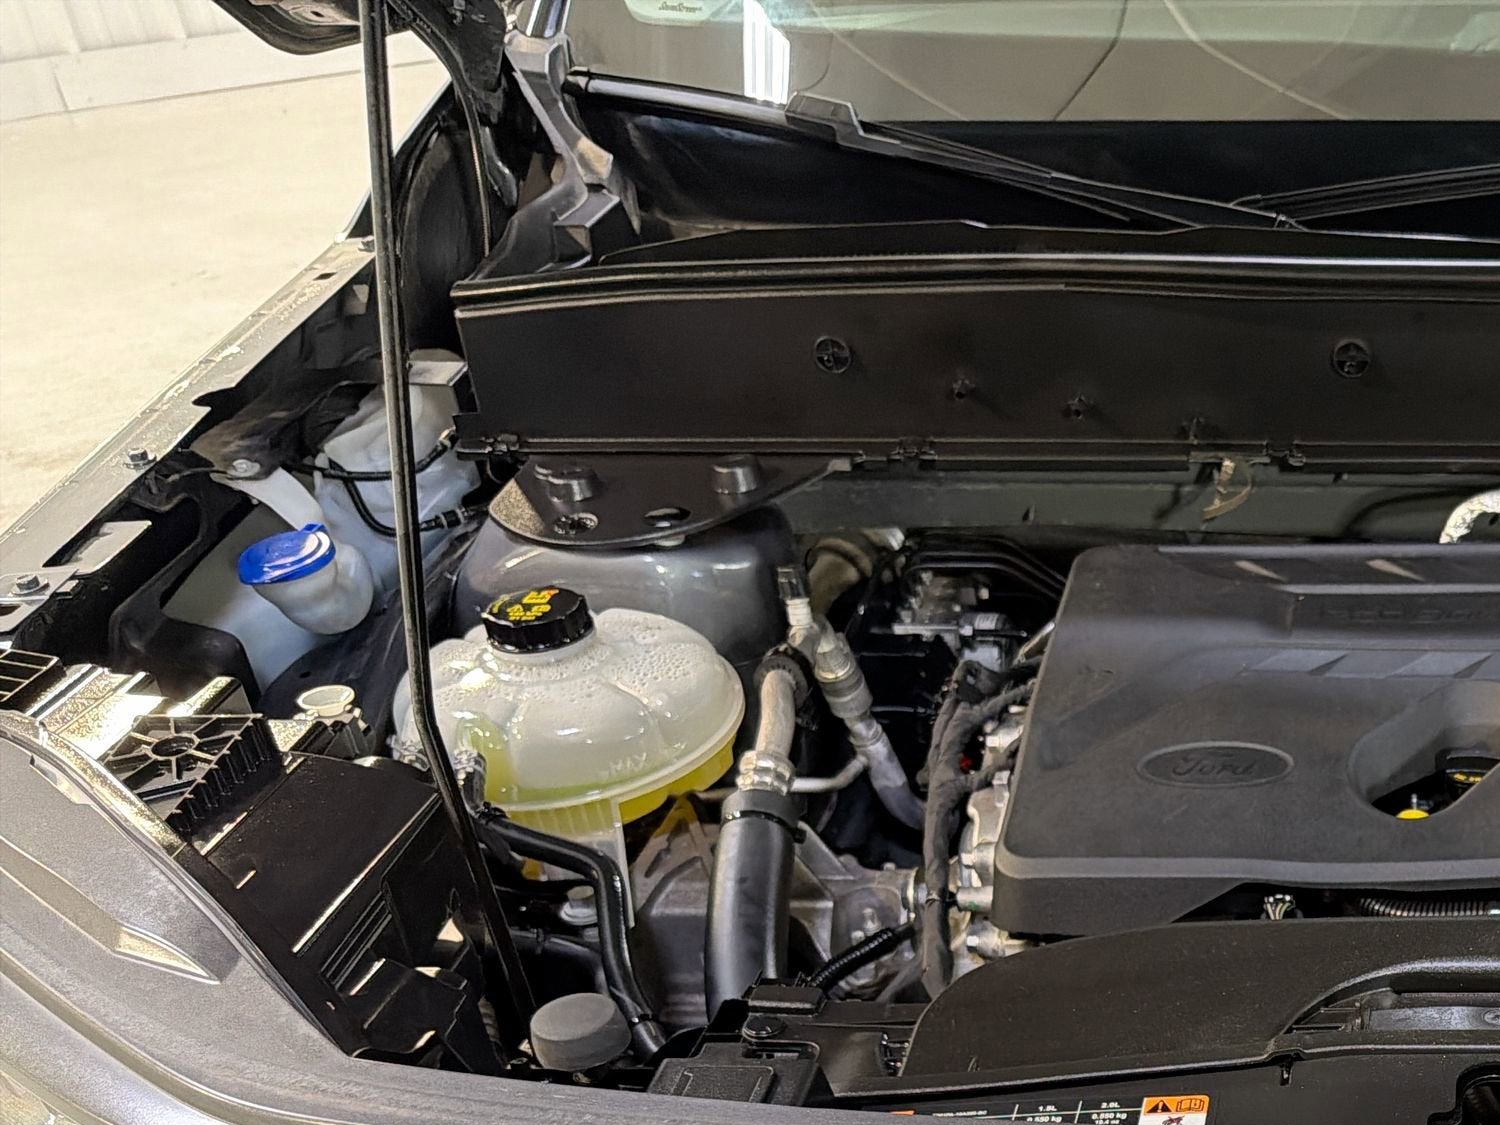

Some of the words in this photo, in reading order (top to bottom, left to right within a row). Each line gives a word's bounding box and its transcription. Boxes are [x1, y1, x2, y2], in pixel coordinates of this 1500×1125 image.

[1172, 753, 1257, 776] Ford
[1038, 1104, 1058, 1112] 1.5L
[1100, 1101, 1120, 1109] 2.0L
